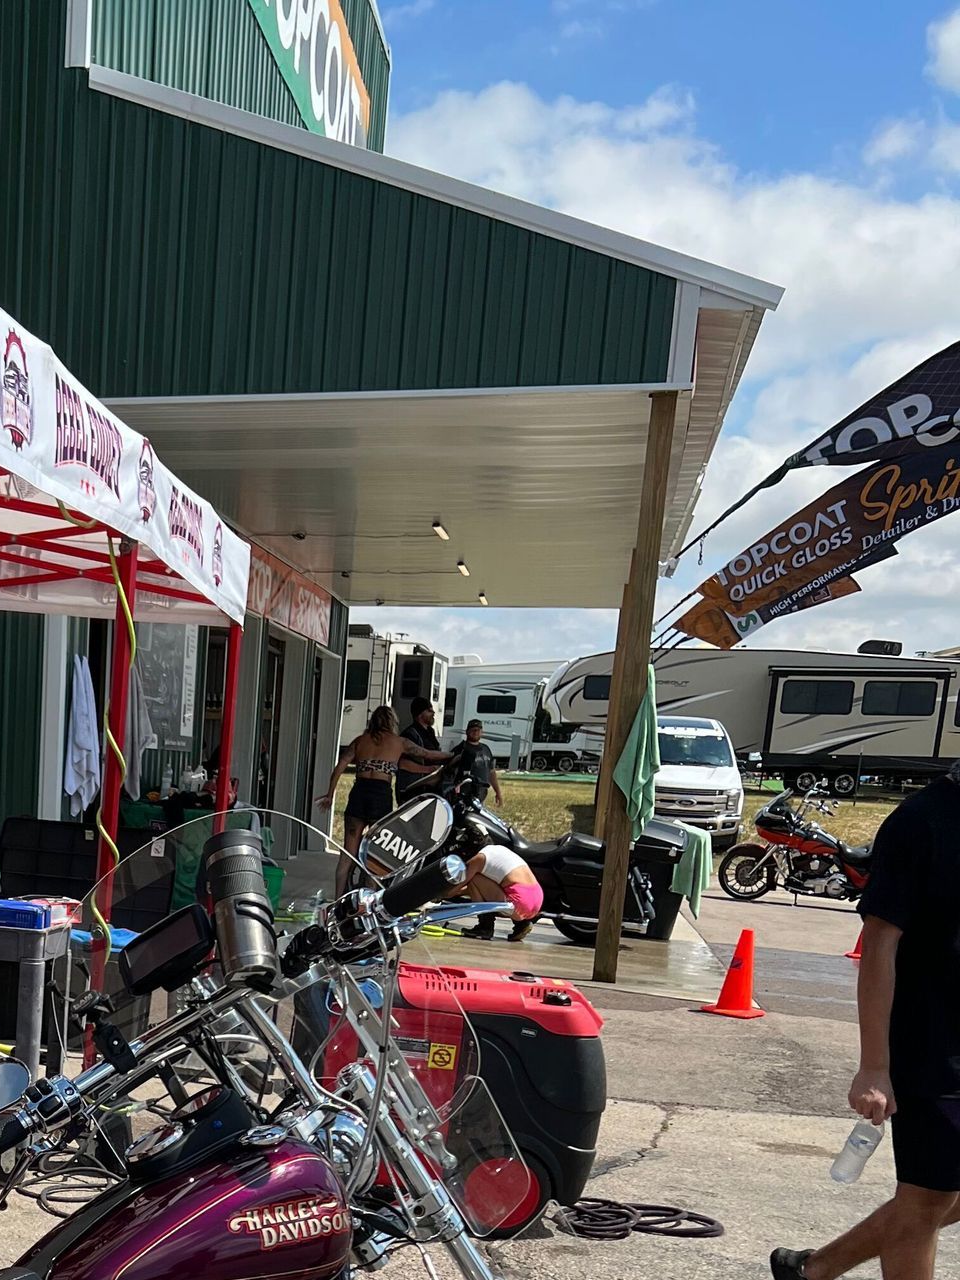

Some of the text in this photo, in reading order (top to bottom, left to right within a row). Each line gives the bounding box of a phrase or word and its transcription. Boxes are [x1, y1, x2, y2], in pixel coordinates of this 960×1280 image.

[802, 393, 960, 466] TOPC
[717, 499, 847, 586] TOPCOAT
[861, 515, 923, 551] Detailer
[925, 504, 939, 520] &
[729, 526, 853, 602] QUICK GLOSS
[769, 597, 793, 616] HIGH
[483, 719, 512, 728] NACLE
[237, 1199, 330, 1233] HARLEY
[262, 1210, 351, 1249] DAVIDSON
